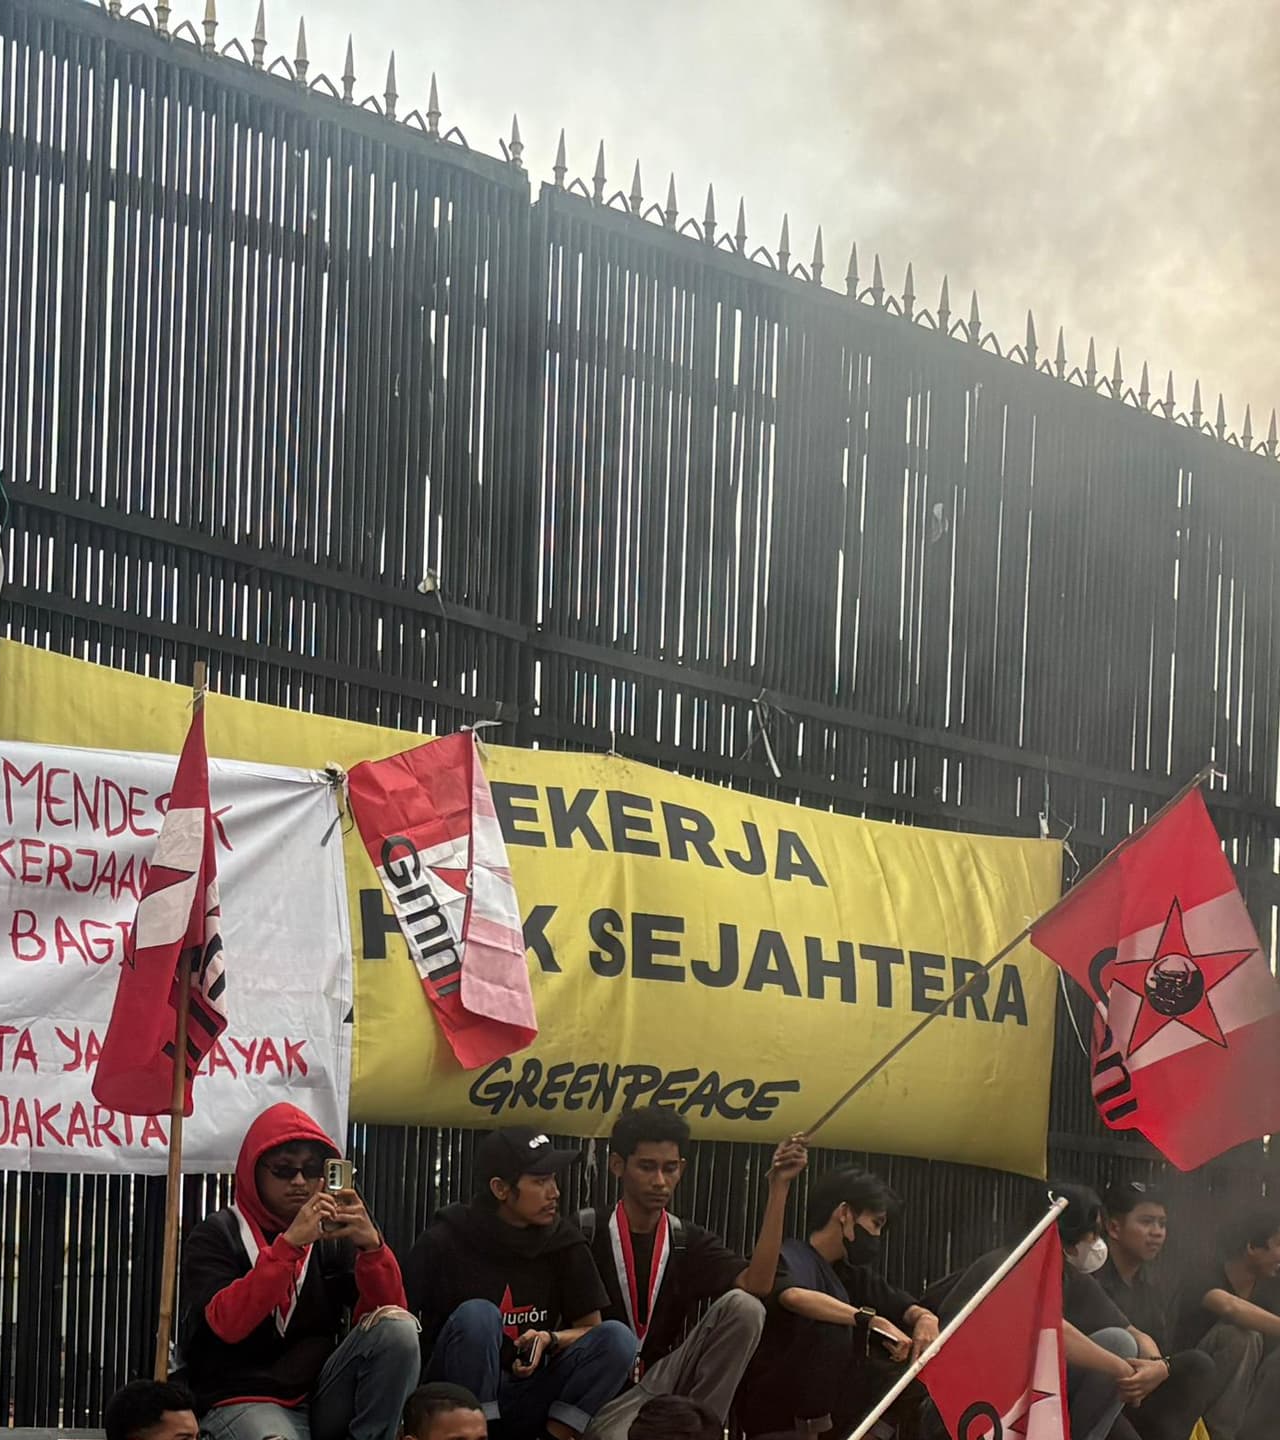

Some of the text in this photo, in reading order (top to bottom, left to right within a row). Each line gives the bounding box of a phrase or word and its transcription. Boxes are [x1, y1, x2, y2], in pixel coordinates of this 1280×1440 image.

[489, 781, 828, 888] EKERJA
[587, 907, 1030, 1026] SEJAHTERA
[467, 1055, 800, 1122] GREENPEACE
